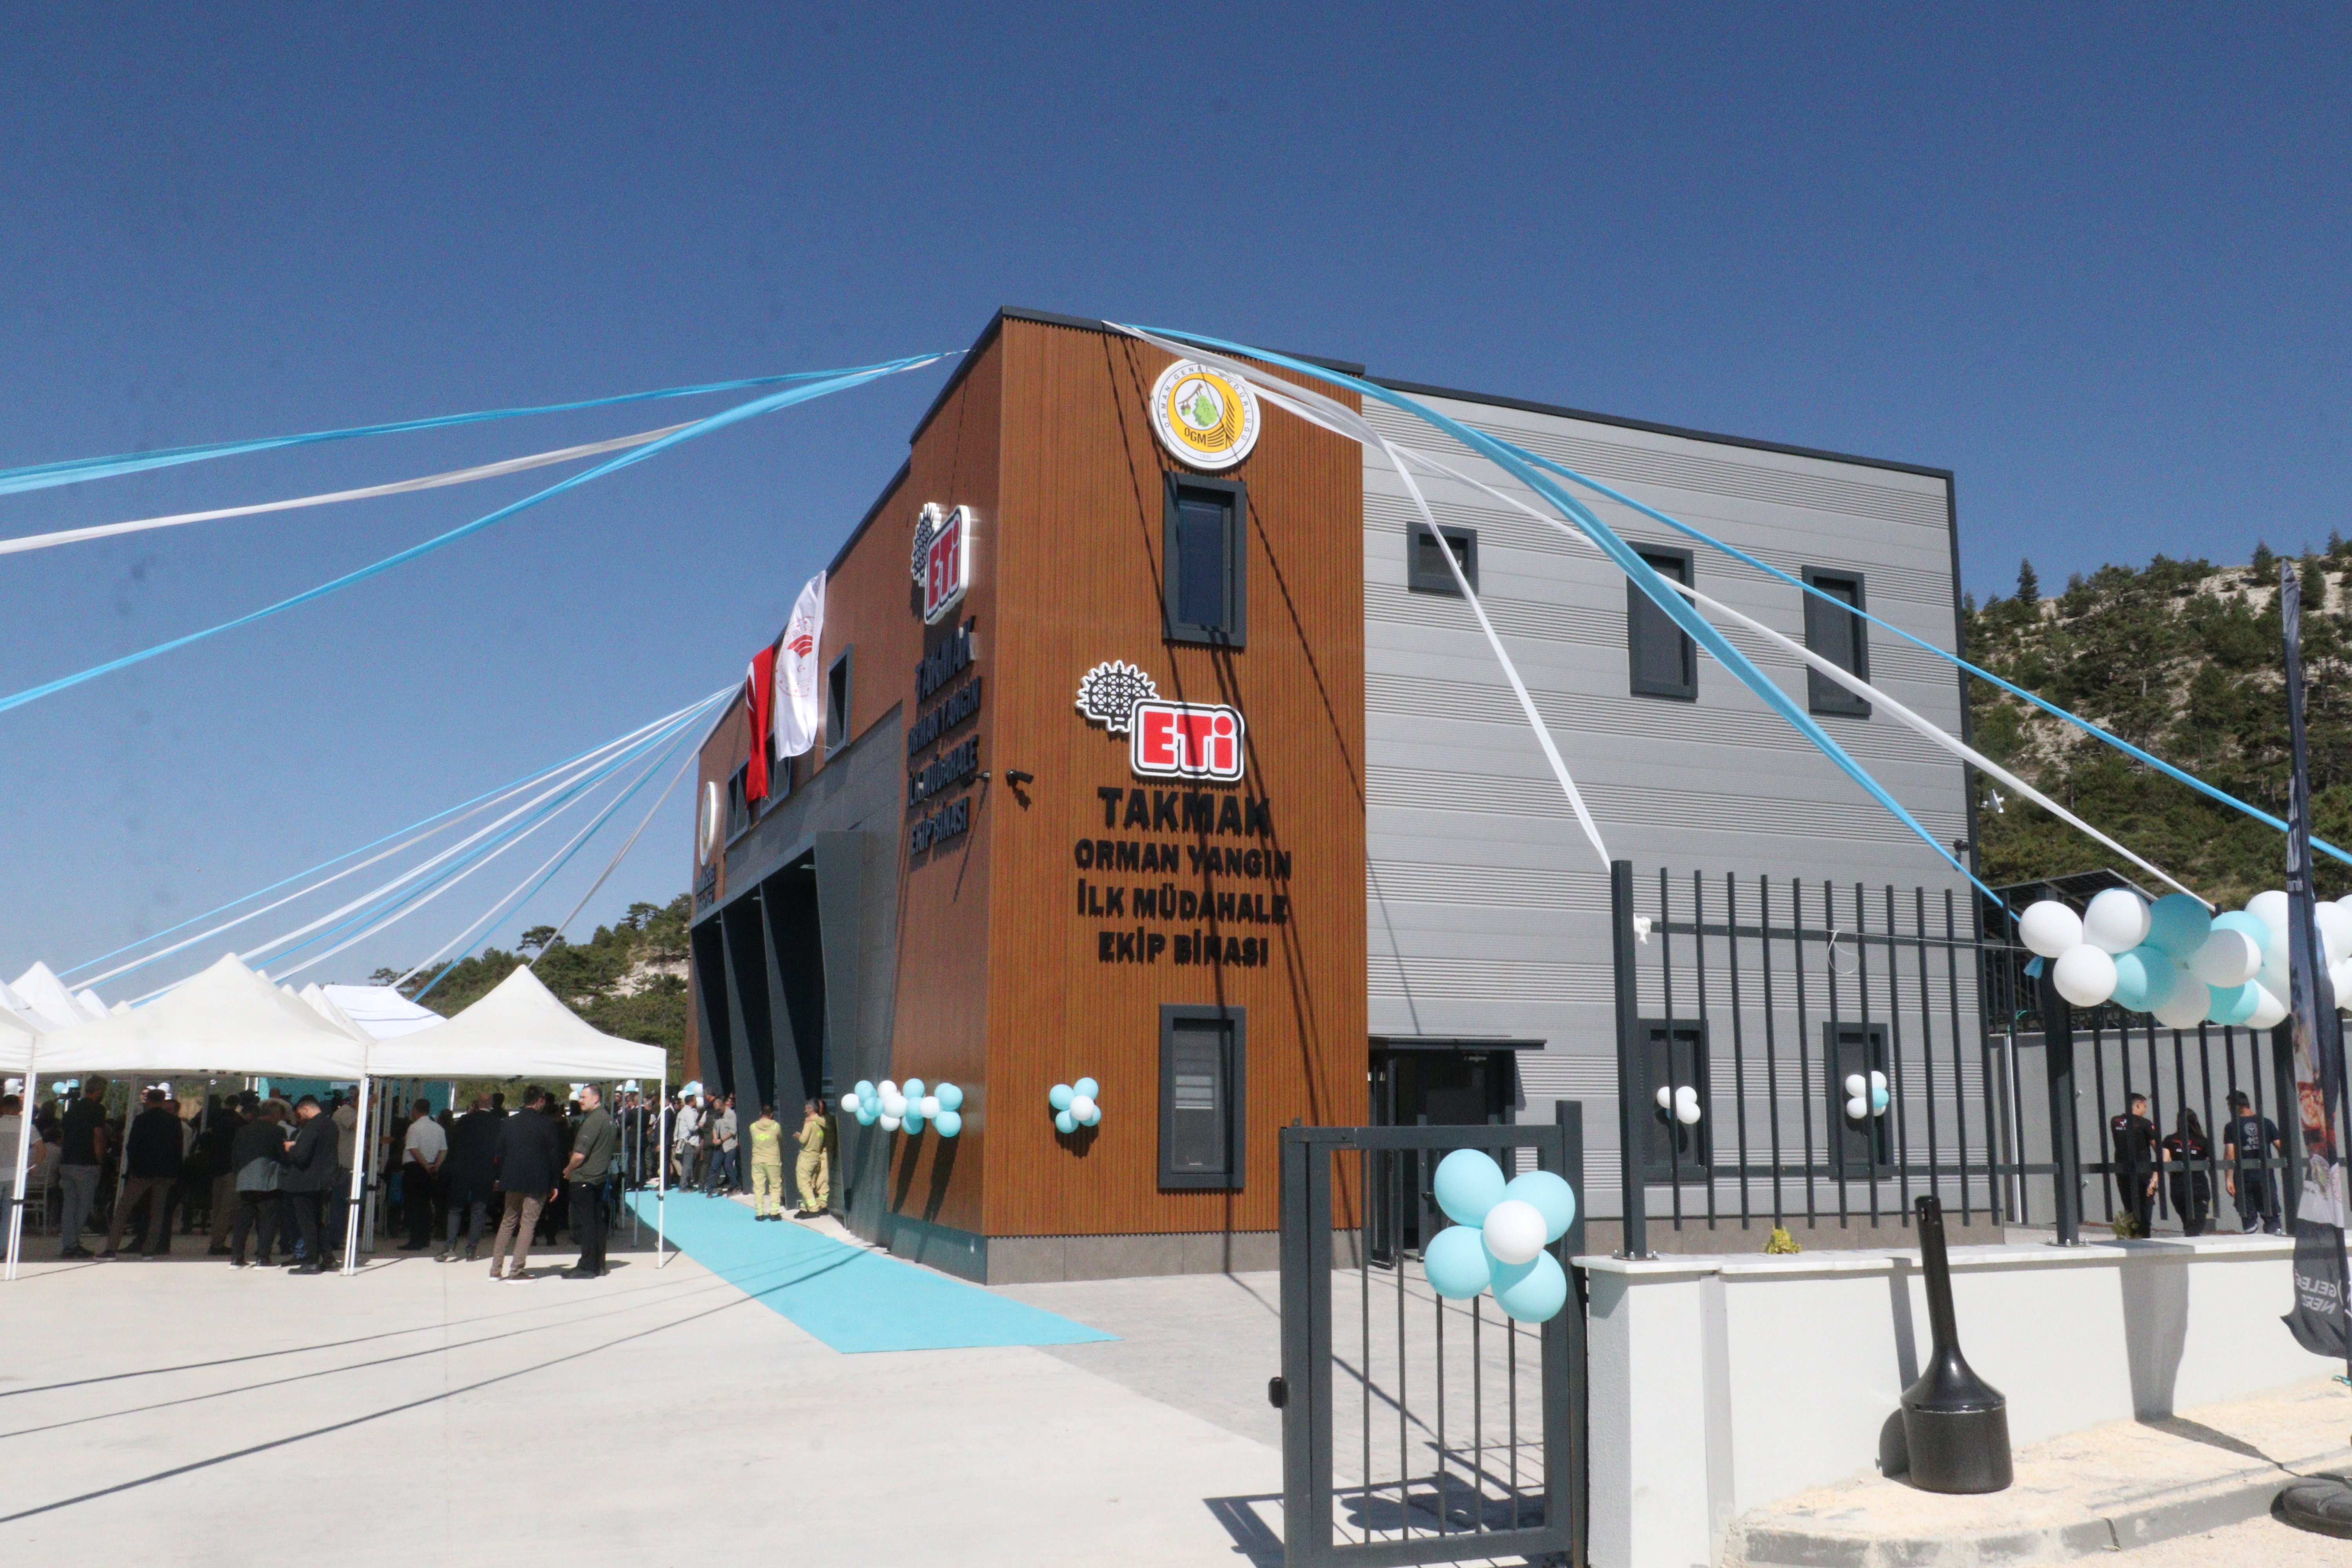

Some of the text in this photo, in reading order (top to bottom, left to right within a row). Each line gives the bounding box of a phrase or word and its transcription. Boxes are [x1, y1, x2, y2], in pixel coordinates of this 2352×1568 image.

[1160, 385, 1171, 428] ORMAN
[1174, 366, 1210, 380] GENEL
[1184, 427, 1207, 446] OGM
[915, 616, 975, 704] TAKMAK
[907, 676, 981, 757] ORMAN YANGIN
[923, 735, 980, 796] MÜDAHALE
[910, 796, 970, 855] EKİP BİNASI
[1098, 786, 1270, 837] TAKMAK
[1074, 838, 1291, 880] ORMAN YANGIN
[1077, 878, 1288, 924] İLK MÜDAHALE
[1099, 926, 1269, 967] EKİP BİNASI
